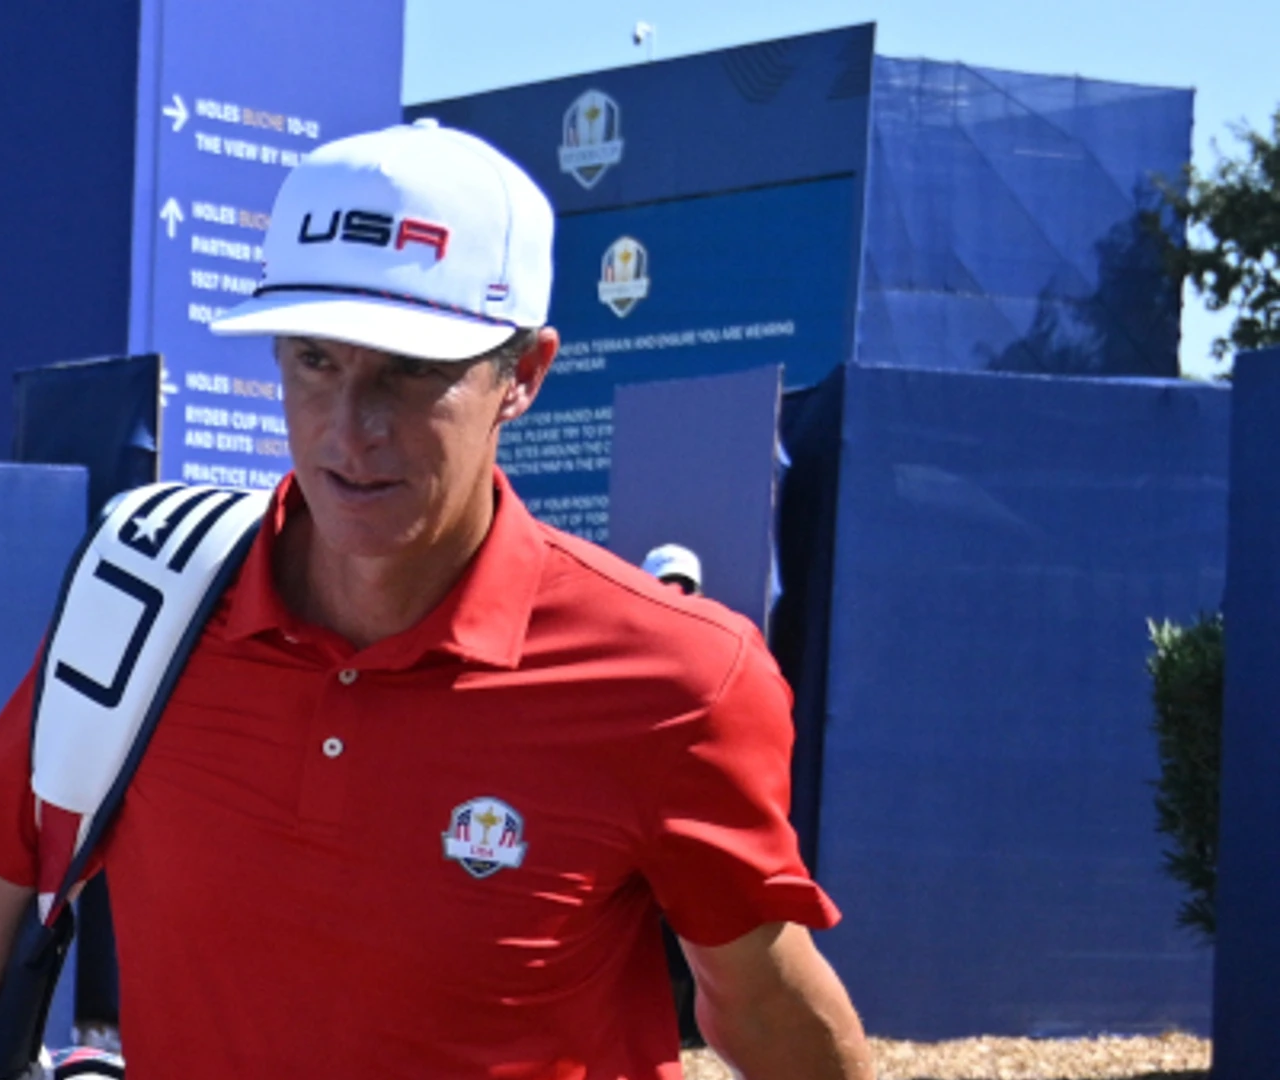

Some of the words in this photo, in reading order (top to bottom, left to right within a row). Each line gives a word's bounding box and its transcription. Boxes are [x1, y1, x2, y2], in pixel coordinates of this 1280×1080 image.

[195, 131, 221, 154] THE
[223, 138, 257, 160] VIEW
[261, 144, 278, 164] BY
[281, 149, 308, 167] HIL
[191, 201, 236, 225] HOLES
[238, 209, 271, 231] BUC
[191, 235, 251, 262] PARTNER
[297, 209, 449, 262] USA
[185, 372, 230, 395] HOLES
[185, 405, 229, 427] RYDER
[232, 411, 257, 430] CUP
[260, 415, 289, 436] VILL
[185, 429, 213, 449] AND
